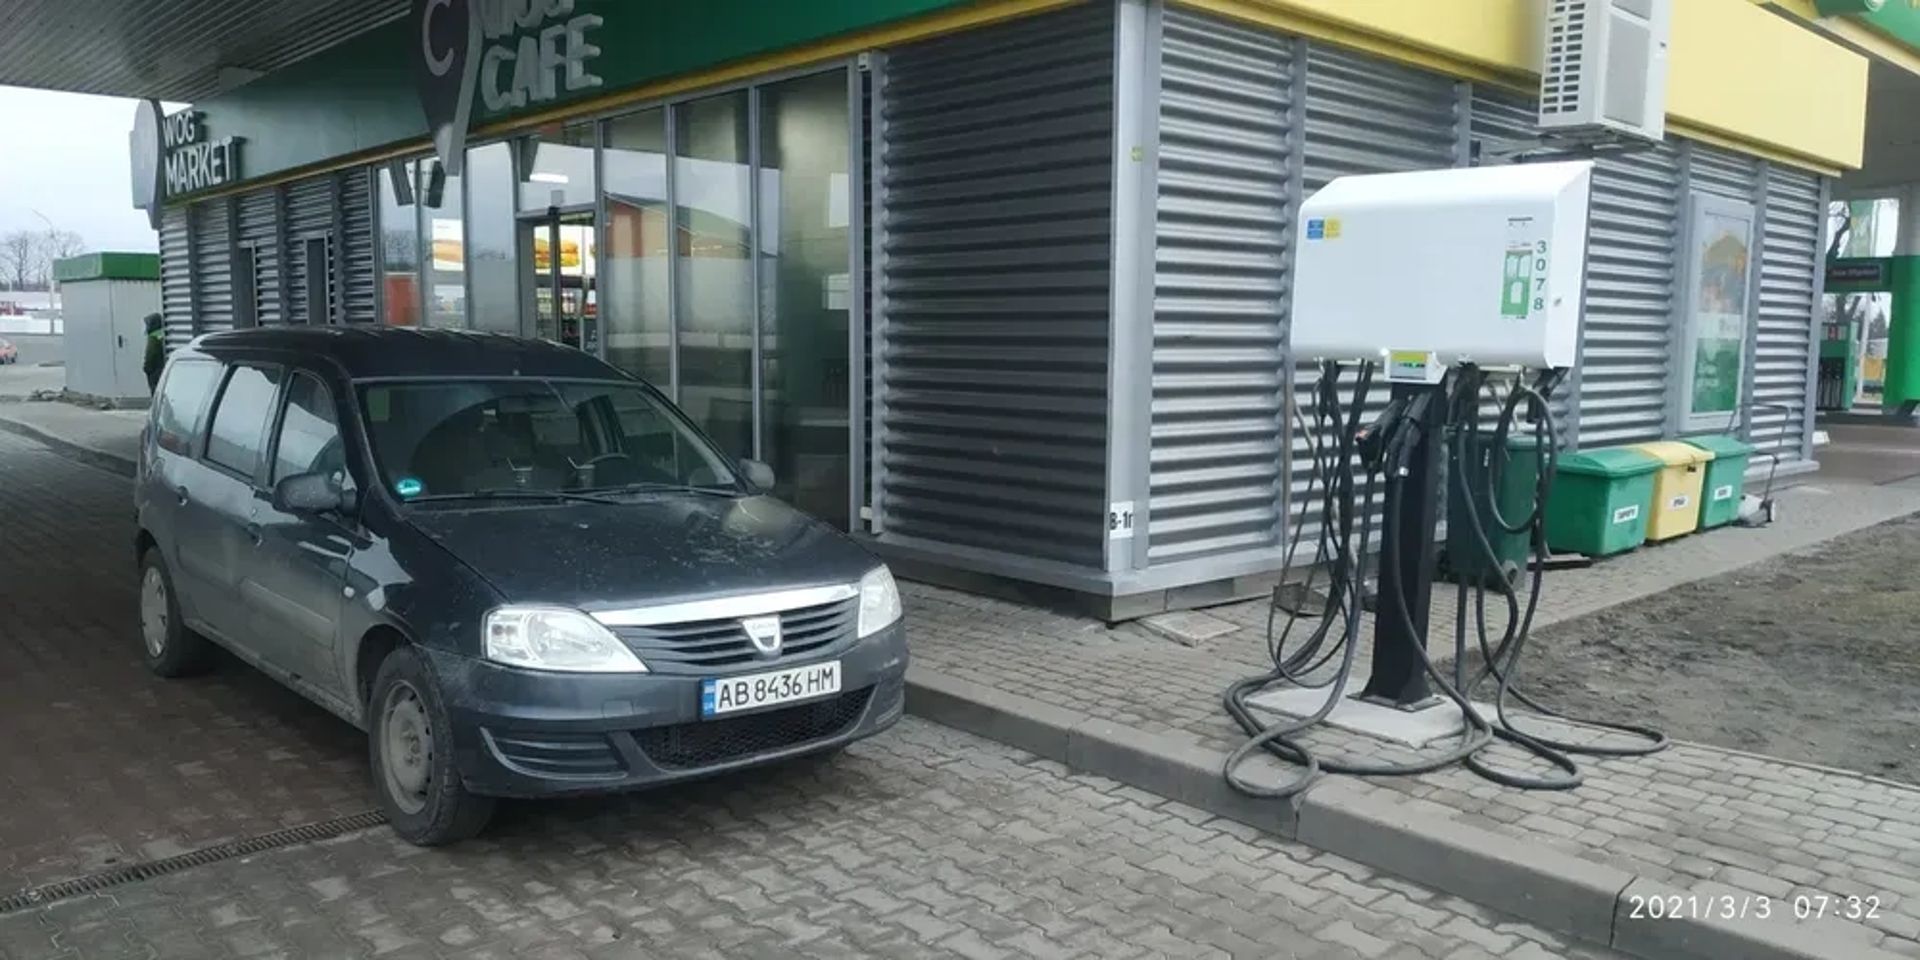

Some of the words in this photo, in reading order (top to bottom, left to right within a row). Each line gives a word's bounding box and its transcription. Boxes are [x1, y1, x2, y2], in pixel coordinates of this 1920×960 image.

[481, 13, 604, 111] CAFE
[162, 110, 195, 148] WOG
[164, 135, 233, 197] MARKET
[1533, 239, 1547, 311] 3078
[718, 682, 750, 709] AB
[753, 674, 803, 702] 8436
[807, 666, 834, 692] HM
